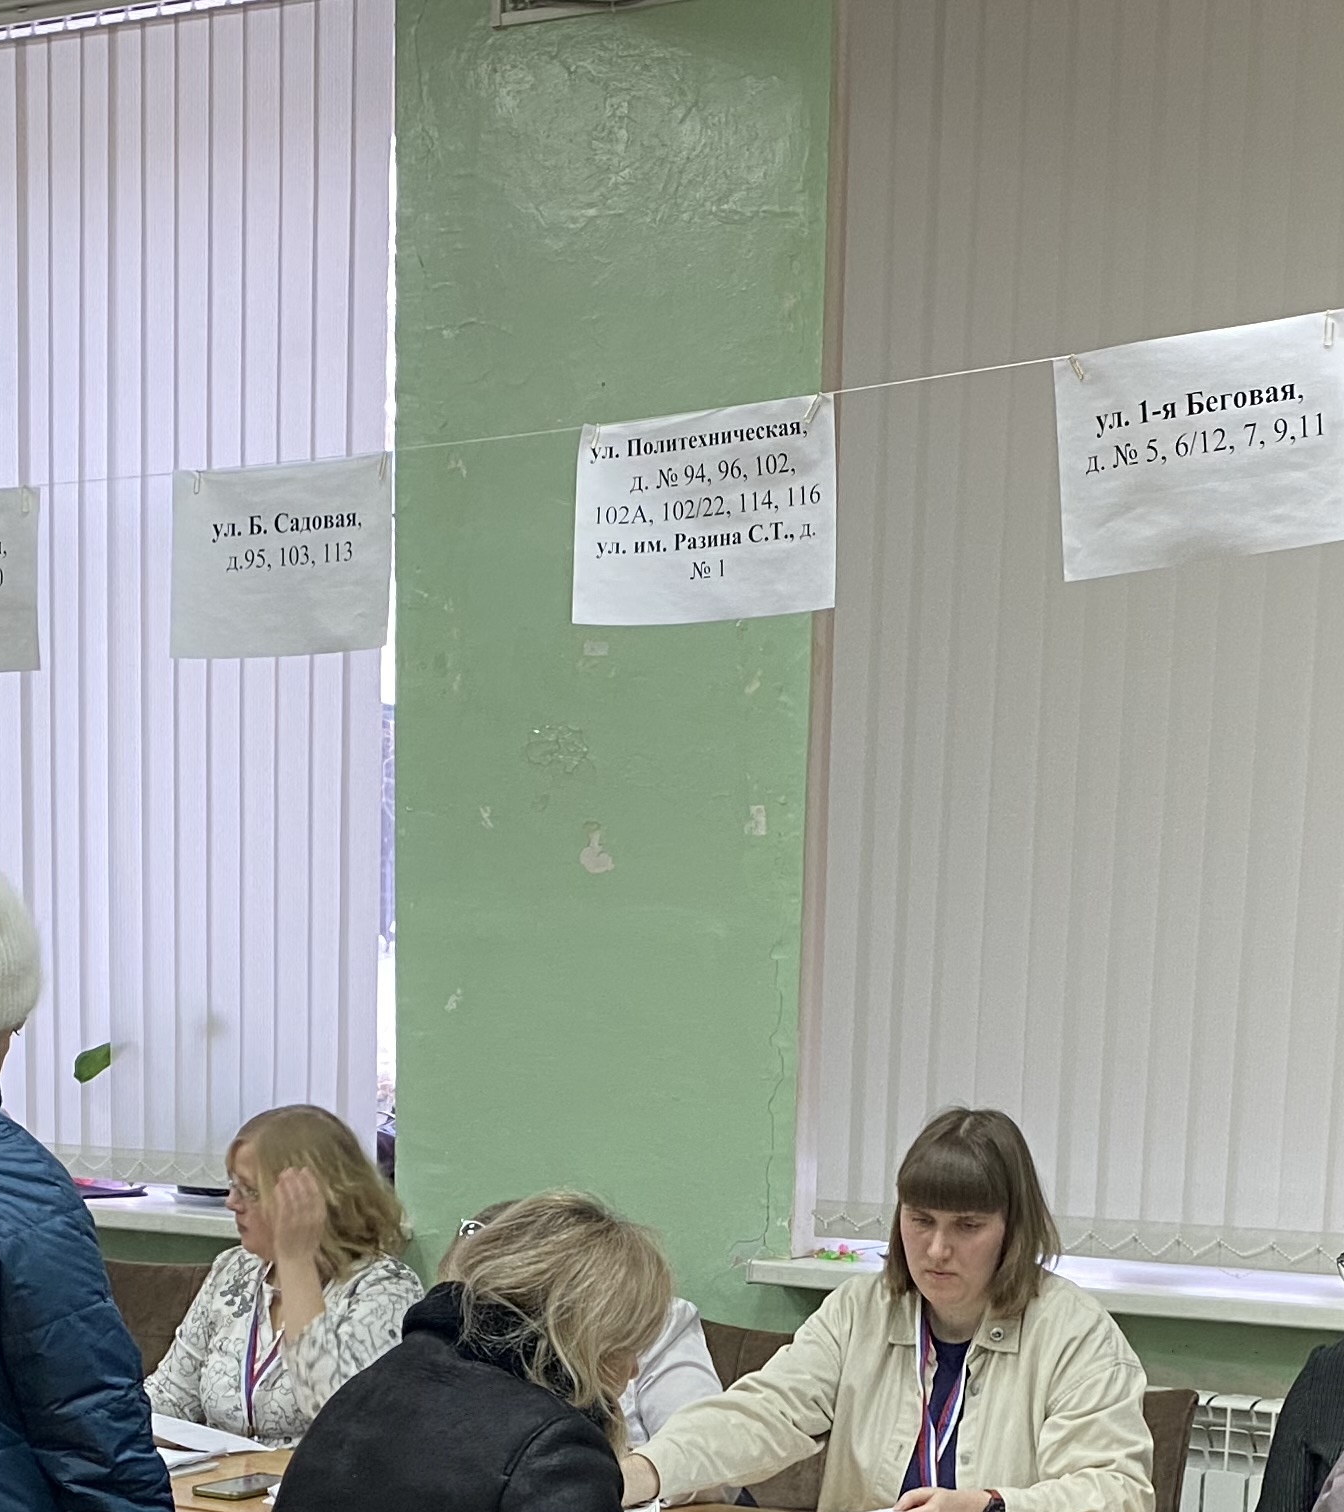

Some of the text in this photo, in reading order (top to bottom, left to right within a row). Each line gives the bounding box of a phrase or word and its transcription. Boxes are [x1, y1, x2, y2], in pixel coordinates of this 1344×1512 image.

[1095, 382, 1304, 438] ул. 1-я Беговая,
[590, 420, 808, 464] ул. Политехническая,
[1085, 455, 1106, 475] д.
[1112, 442, 1139, 468] №
[1146, 438, 1167, 464] 5,
[1175, 427, 1236, 458] 6/12,
[1244, 422, 1265, 447] 7,
[629, 452, 796, 493] д. № 94, 96, 102,
[595, 483, 821, 527] 102А, 102/22, 114, 116
[211, 511, 362, 543] ул. Б. Садовая,
[595, 521, 817, 559] ул. им. Разина С.Т., д.
[280, 544, 316, 568] 103,
[324, 540, 353, 564] 113
[690, 559, 725, 580] № 1
